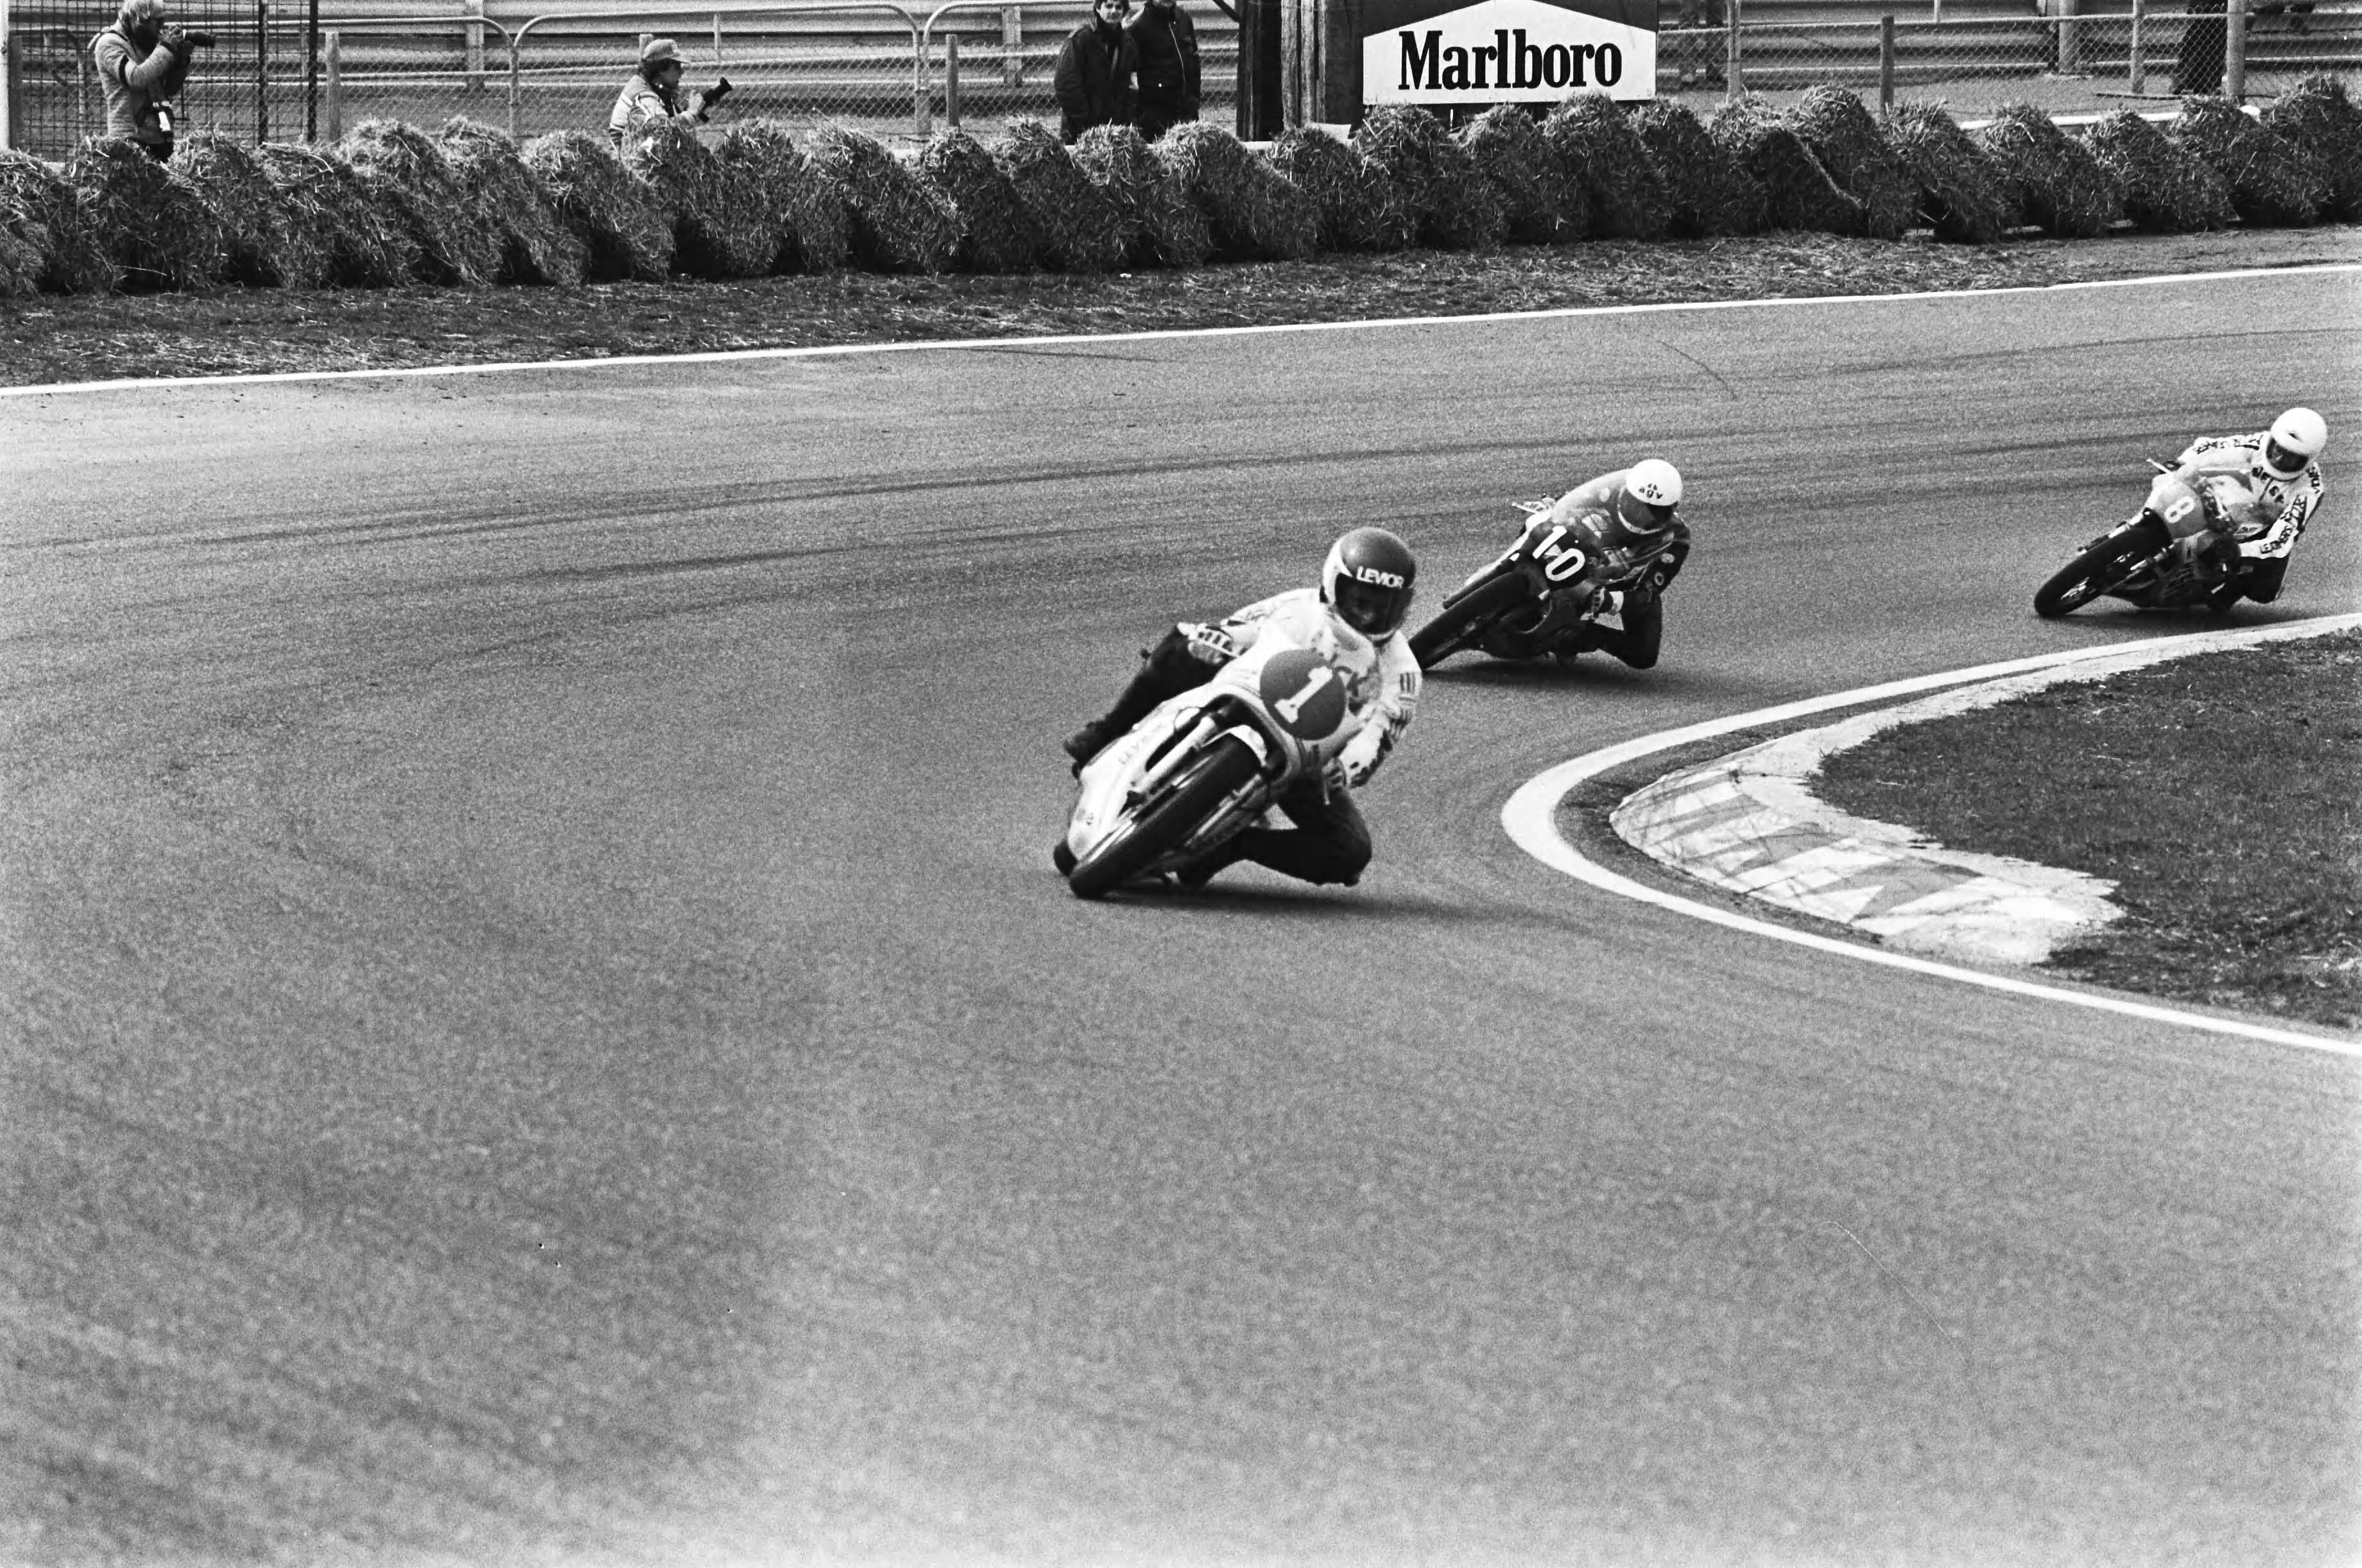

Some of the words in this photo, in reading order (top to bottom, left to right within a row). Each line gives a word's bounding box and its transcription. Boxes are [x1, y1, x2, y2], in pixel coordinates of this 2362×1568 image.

[1398, 29, 1623, 90] Marlboro
[2164, 496, 2194, 524] 8
[1532, 525, 1585, 582] 10
[1274, 665, 1333, 724] 1
